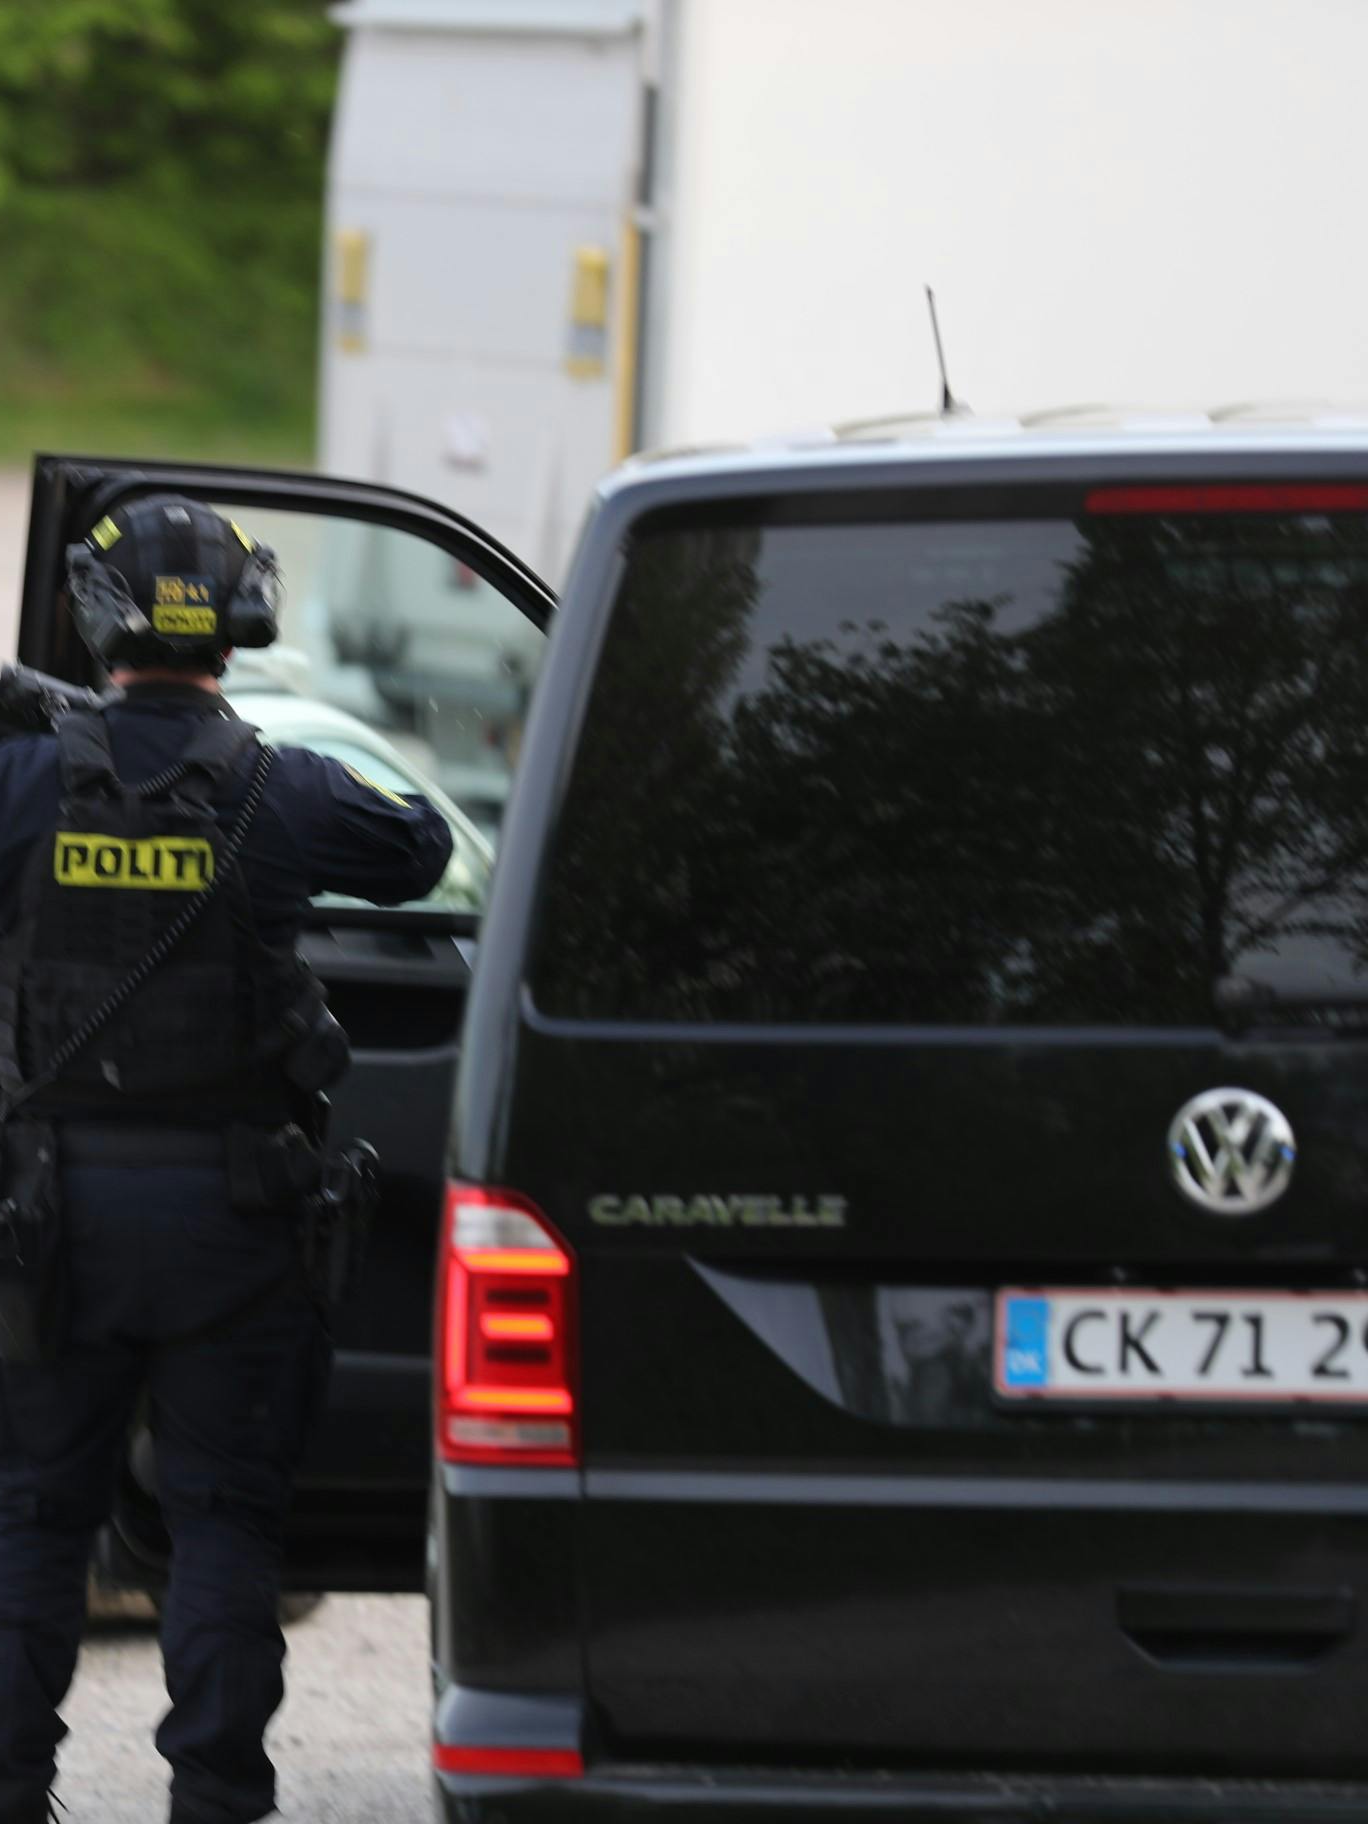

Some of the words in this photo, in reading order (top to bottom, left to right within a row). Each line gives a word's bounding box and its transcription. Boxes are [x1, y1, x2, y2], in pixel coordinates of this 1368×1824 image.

[60, 845, 209, 882] POLITI
[588, 1193, 847, 1226] CARAVELLE
[1063, 1308, 1164, 1377] CK
[1190, 1309, 1275, 1380] 71
[1310, 1311, 1368, 1381] 2
